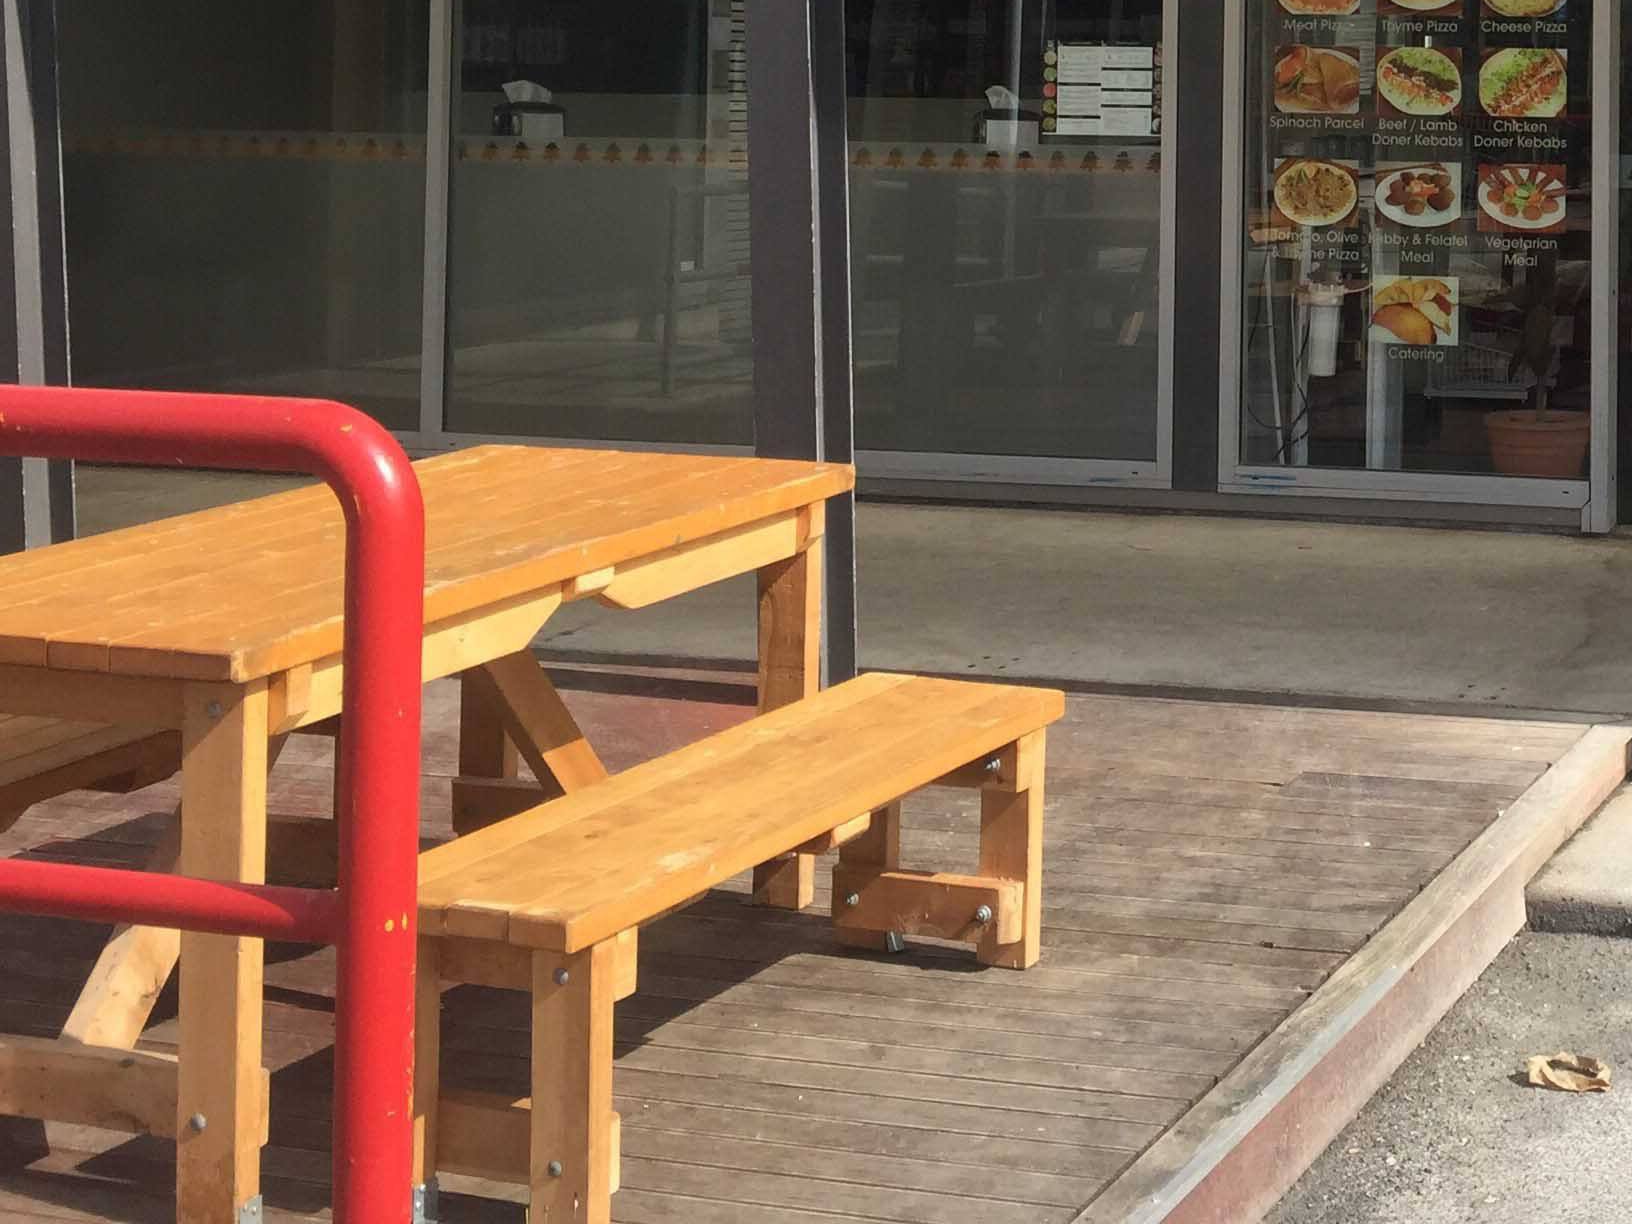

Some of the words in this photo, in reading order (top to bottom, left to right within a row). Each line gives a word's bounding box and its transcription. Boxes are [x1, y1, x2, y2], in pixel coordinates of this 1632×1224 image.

[1283, 19, 1317, 32] Meat
[1320, 19, 1356, 32] Pizz
[1381, 20, 1424, 34] Thyme
[1427, 20, 1459, 33] Pizza
[1480, 20, 1531, 33] Cheese
[1534, 21, 1568, 33] Pizza
[1270, 116, 1322, 130] Spinach
[1325, 117, 1365, 129] Parcel
[1378, 118, 1408, 131] Beef
[1420, 119, 1458, 132] Lamb
[1493, 120, 1548, 133] Chicken
[1372, 134, 1411, 146] Doner
[1414, 134, 1464, 147] Kebabs
[1473, 136, 1514, 148] Doner
[1517, 136, 1568, 149] Kebabs
[1327, 230, 1359, 243] Olive
[1412, 233, 1422, 245] &
[1485, 235, 1558, 252] Vegetarian
[1328, 247, 1360, 260] Pizza
[1400, 250, 1434, 263] Meal
[1504, 254, 1538, 267] Meal
[1388, 347, 1444, 361] Catering
